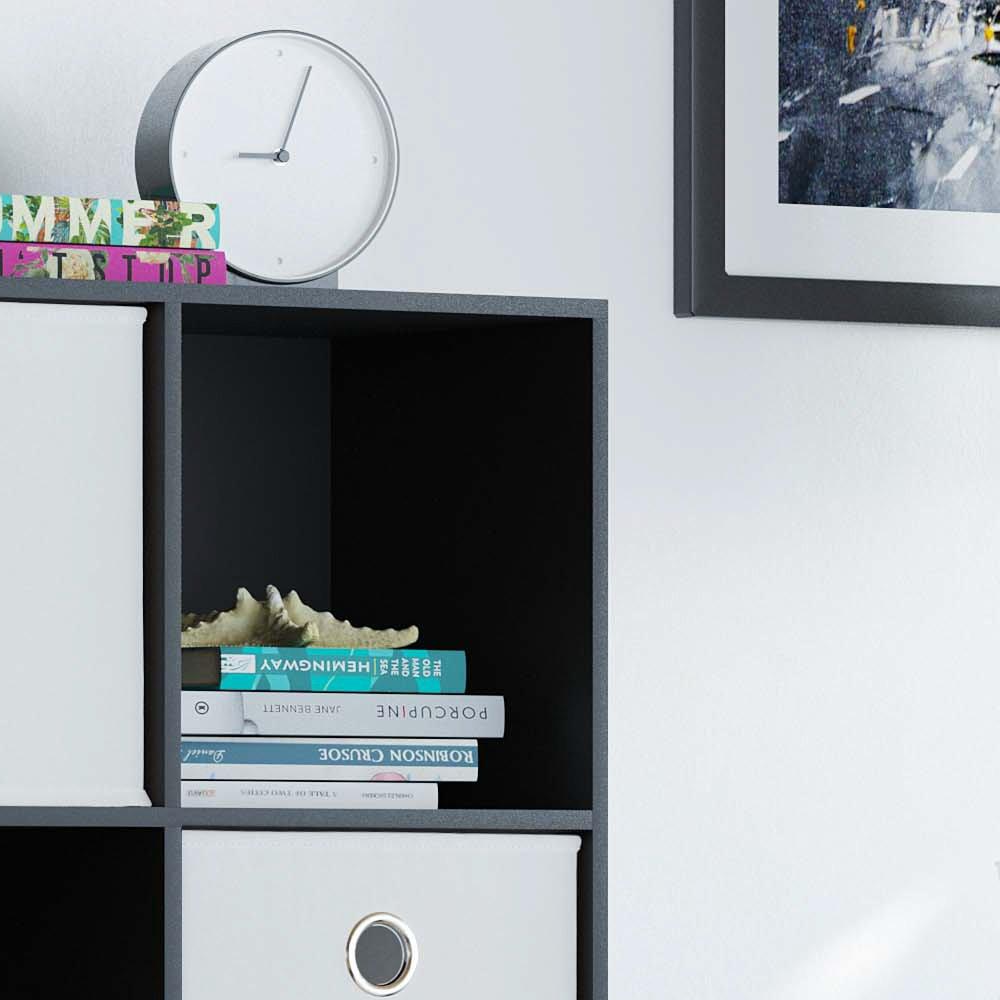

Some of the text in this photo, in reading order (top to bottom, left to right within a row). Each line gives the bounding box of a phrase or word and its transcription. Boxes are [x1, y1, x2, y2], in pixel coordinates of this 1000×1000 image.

[92, 251, 212, 284] STOP
[260, 658, 370, 673] HEMINGWAY
[380, 659, 388, 676] SEA
[390, 658, 399, 676] THE
[401, 657, 409, 677] AND
[412, 658, 420, 677] MAN
[422, 659, 430, 677] OLD
[434, 659, 442, 677] THE
[263, 704, 341, 714] JANE BENNETT
[376, 704, 488, 720] PORCUPINE
[319, 748, 474, 763] ROBINSON CRUSOE
